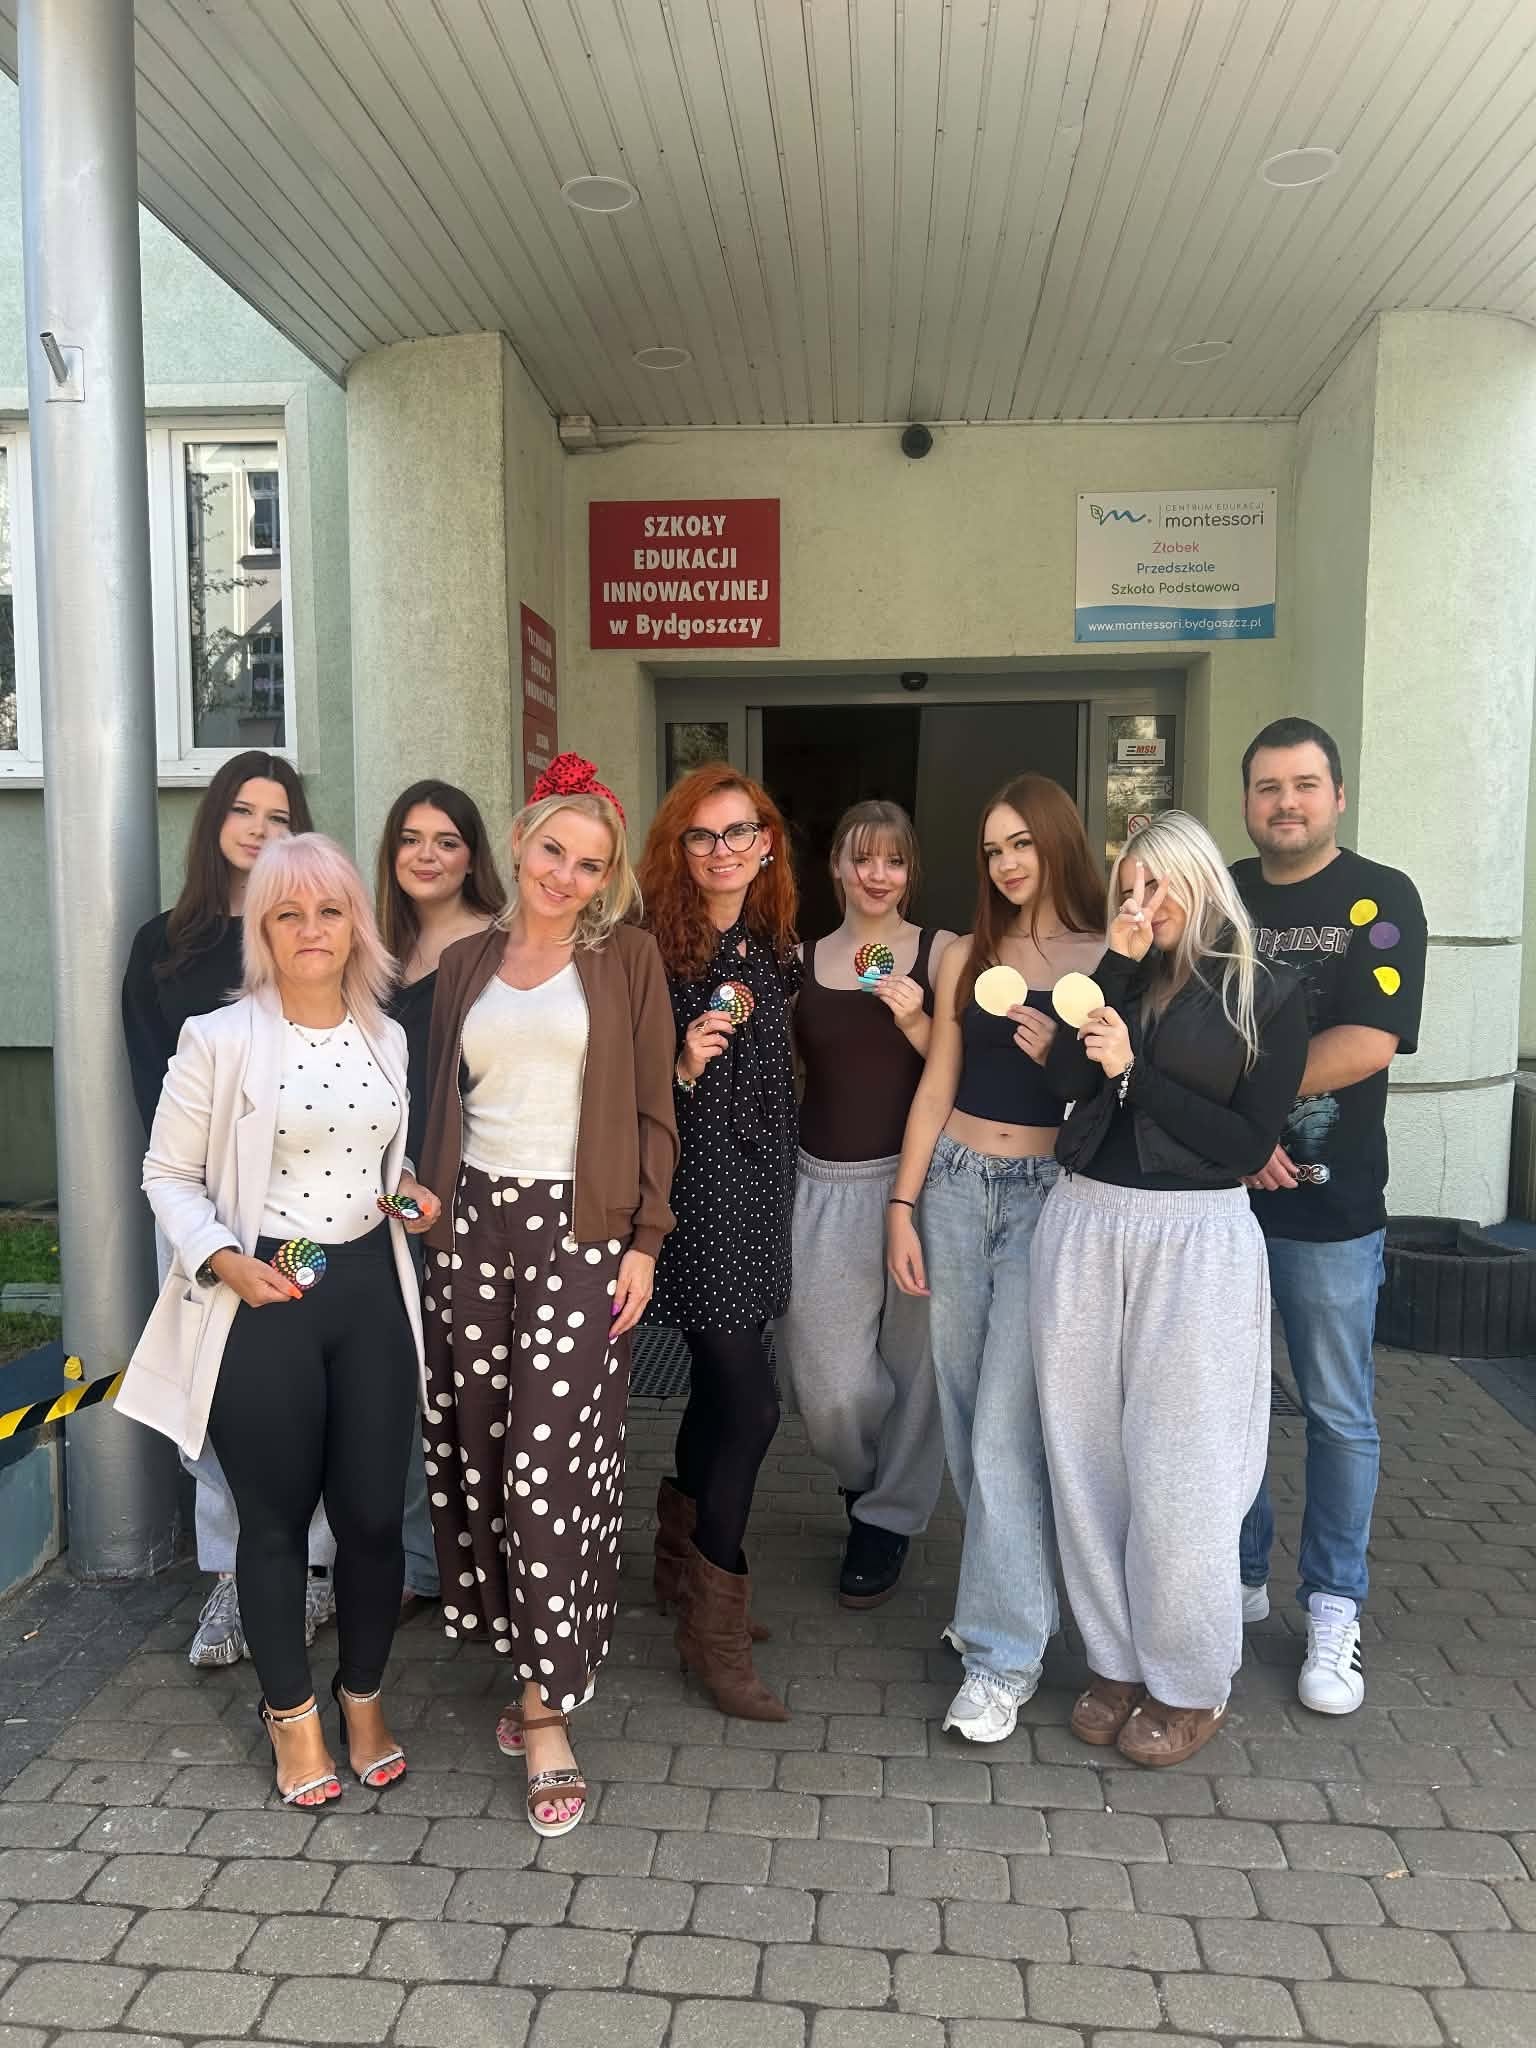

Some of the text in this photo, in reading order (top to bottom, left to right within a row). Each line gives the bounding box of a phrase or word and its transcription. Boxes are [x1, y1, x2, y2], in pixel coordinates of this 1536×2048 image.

[1165, 502, 1265, 512] CENTRUM EDUKACJI
[643, 515, 727, 537] SZKOŁY
[1165, 510, 1265, 528] montessori
[1151, 540, 1200, 554] Żłobek
[633, 547, 737, 570] EDUKACJI
[1136, 561, 1216, 575] Przedszkole
[602, 579, 769, 603] INNOWACYJNEJ
[1111, 581, 1240, 595] Szkoła Podstawowa
[609, 612, 763, 641] w Bydgoszczy
[1088, 617, 1262, 632] www.montessori.bydgoszcz.pl
[1258, 926, 1353, 957] MAIDEN
